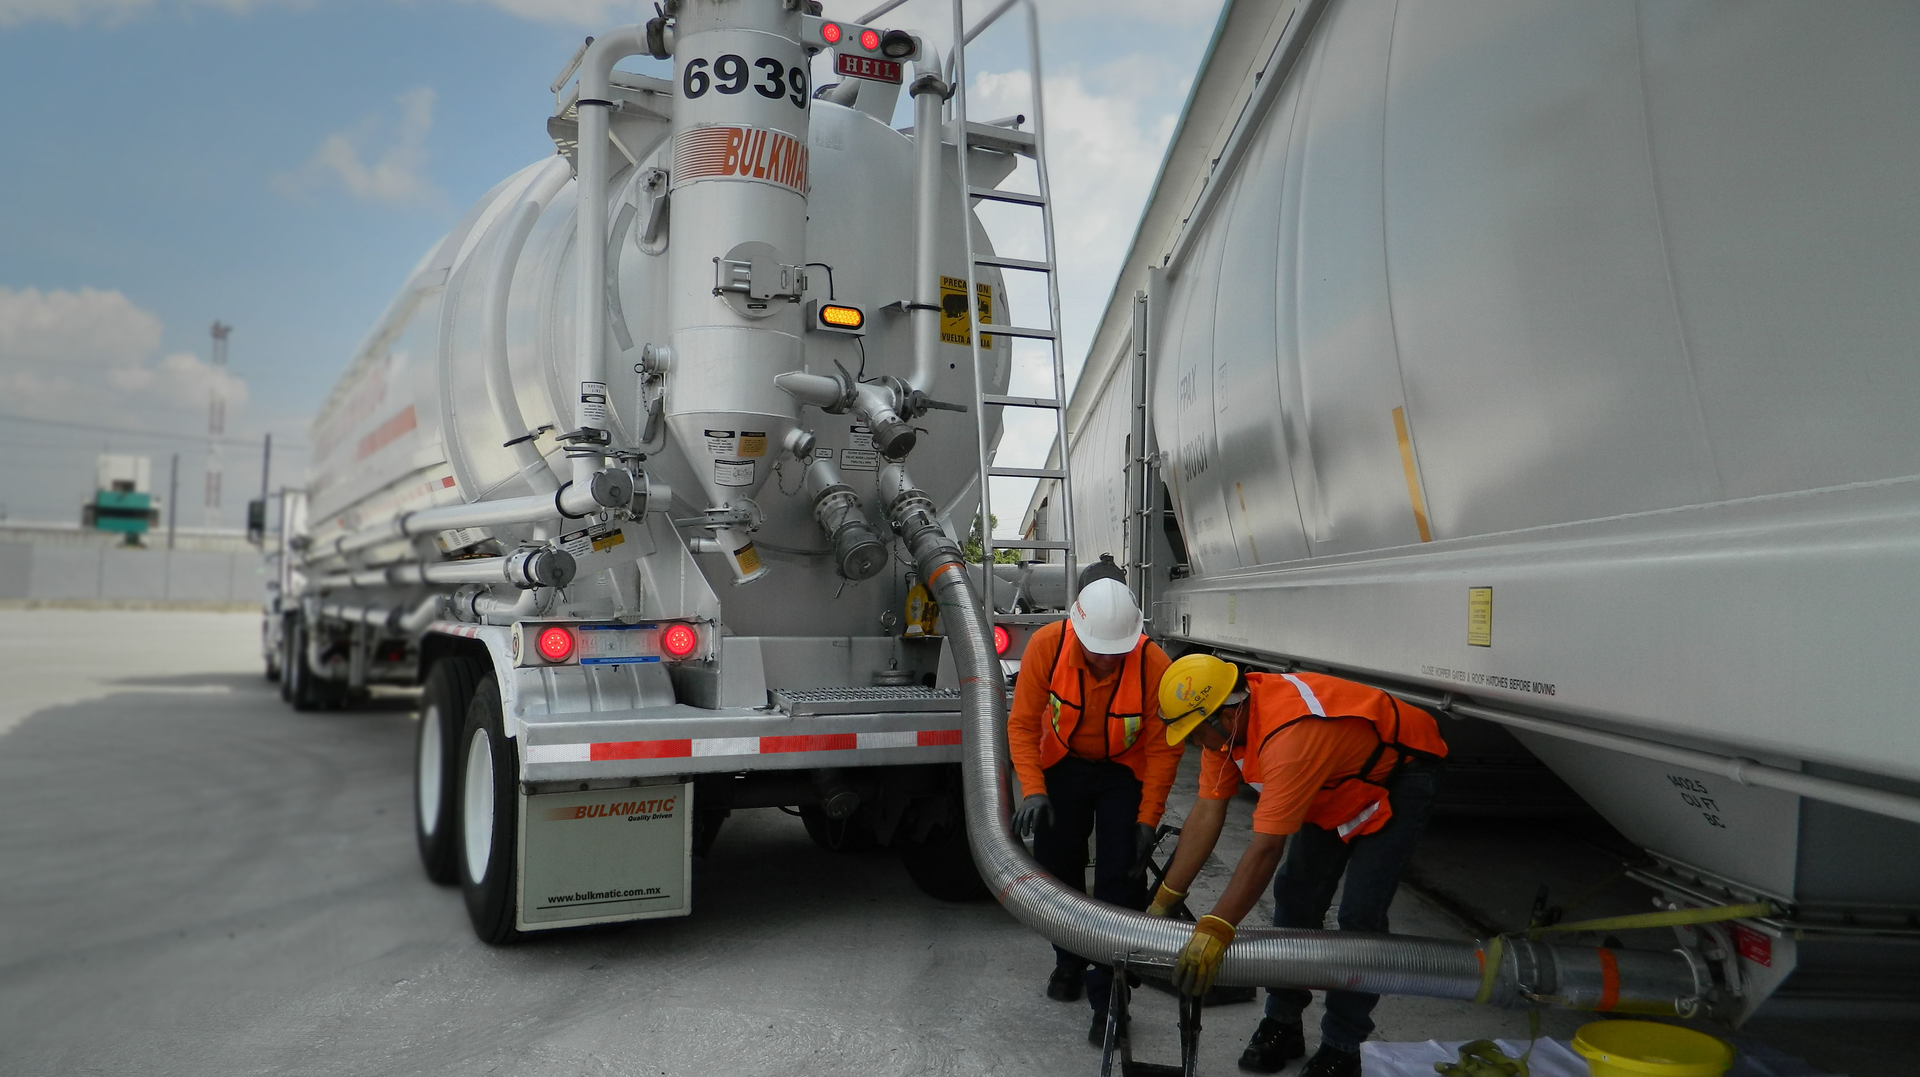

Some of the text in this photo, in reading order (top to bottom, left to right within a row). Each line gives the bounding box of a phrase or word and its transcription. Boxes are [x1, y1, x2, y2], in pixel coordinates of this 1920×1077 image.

[845, 57, 894, 78] HEIL
[683, 54, 807, 109] 6939
[941, 332, 965, 344] VUELTA
[1421, 665, 1435, 676] CLOSE
[1435, 667, 1451, 678] HOPPER
[1452, 669, 1466, 682] GATES
[1471, 673, 1485, 685] ROOF
[1486, 675, 1508, 689] HATCHES
[1509, 678, 1531, 692] BEFORE
[1532, 682, 1556, 696] MOVING
[574, 798, 676, 819] BULKMATIC
[1681, 792, 1720, 812] CU FT
[627, 812, 673, 822] Quality Driven
[1702, 812, 1726, 829] BC
[547, 886, 661, 904] www.bulkmatic.com.mx
